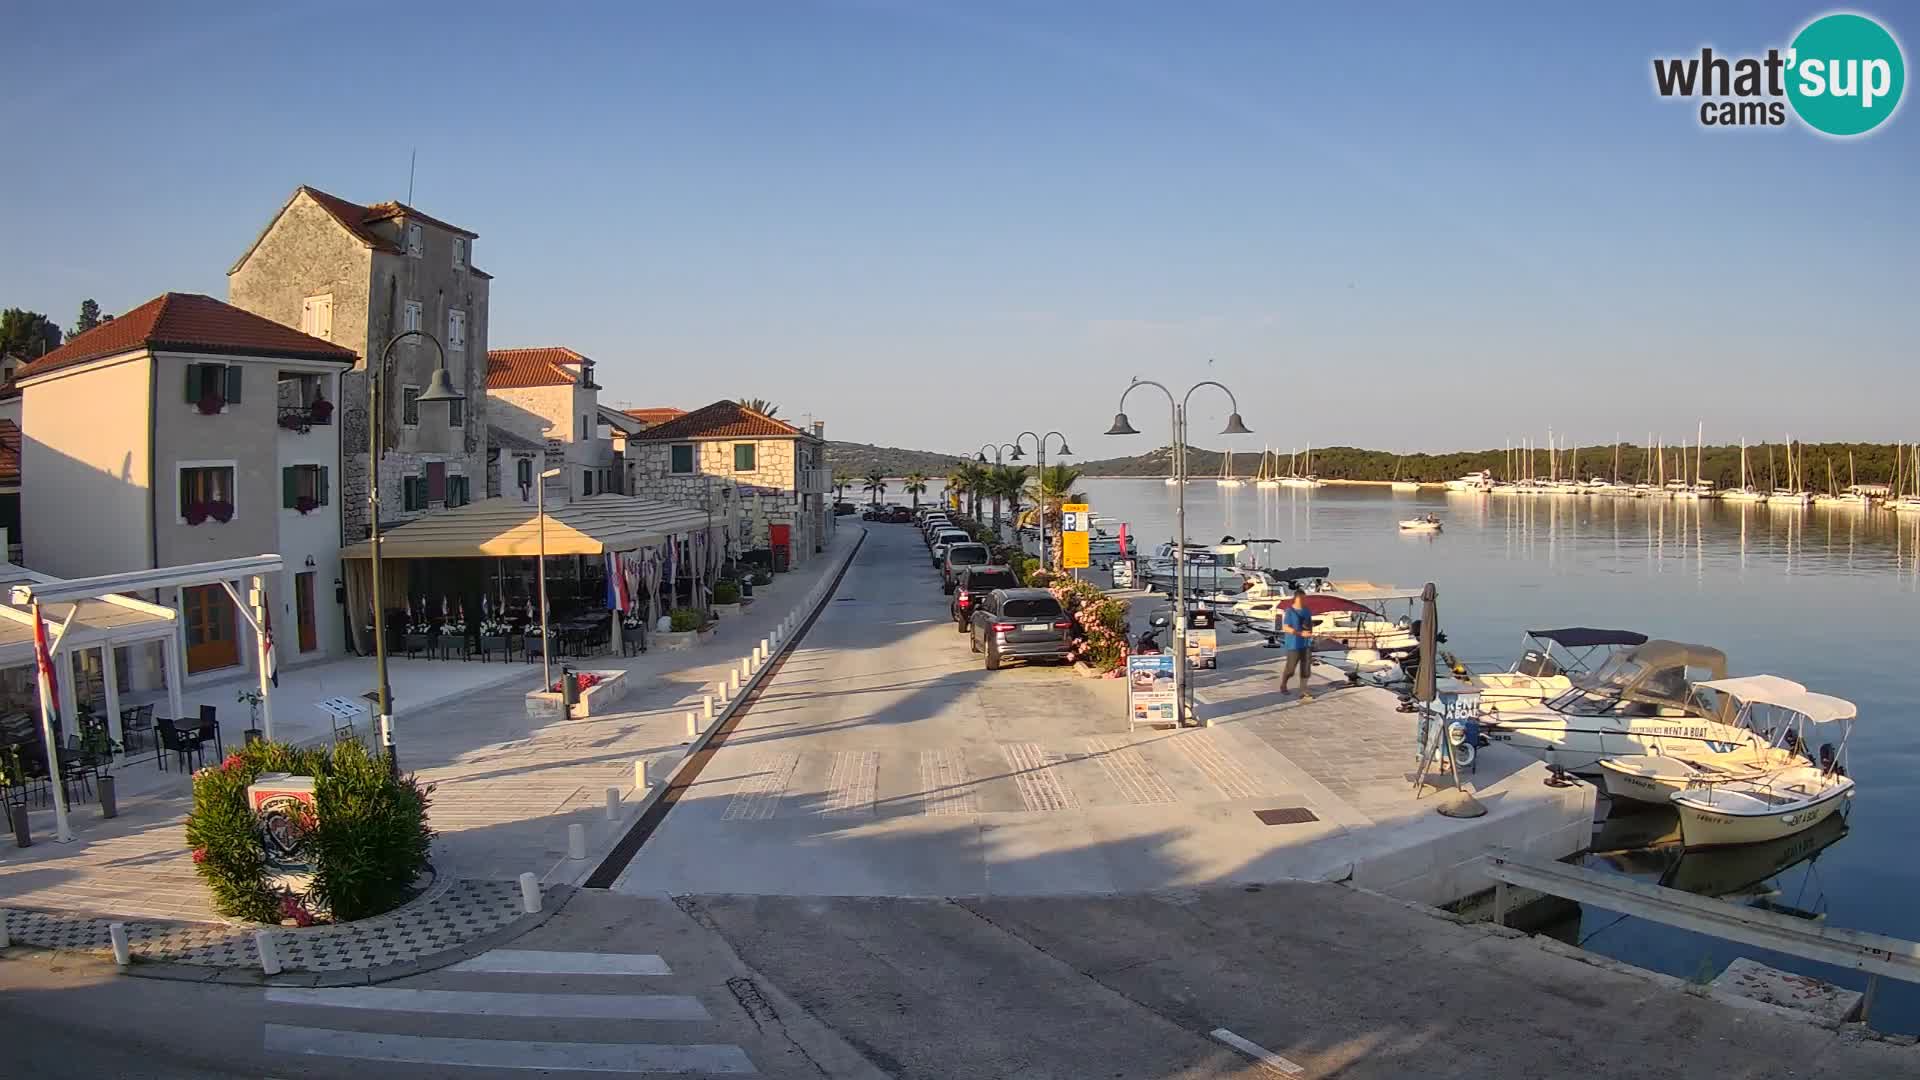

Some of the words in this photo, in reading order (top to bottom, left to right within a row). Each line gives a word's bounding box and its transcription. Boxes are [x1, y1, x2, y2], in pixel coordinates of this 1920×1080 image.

[1065, 514, 1075, 530] P
[1447, 699, 1477, 710] RENT
[1446, 709, 1453, 720] A
[1663, 726, 1683, 737] RENT
[1683, 726, 1689, 737] A
[1690, 727, 1708, 738] BOAT
